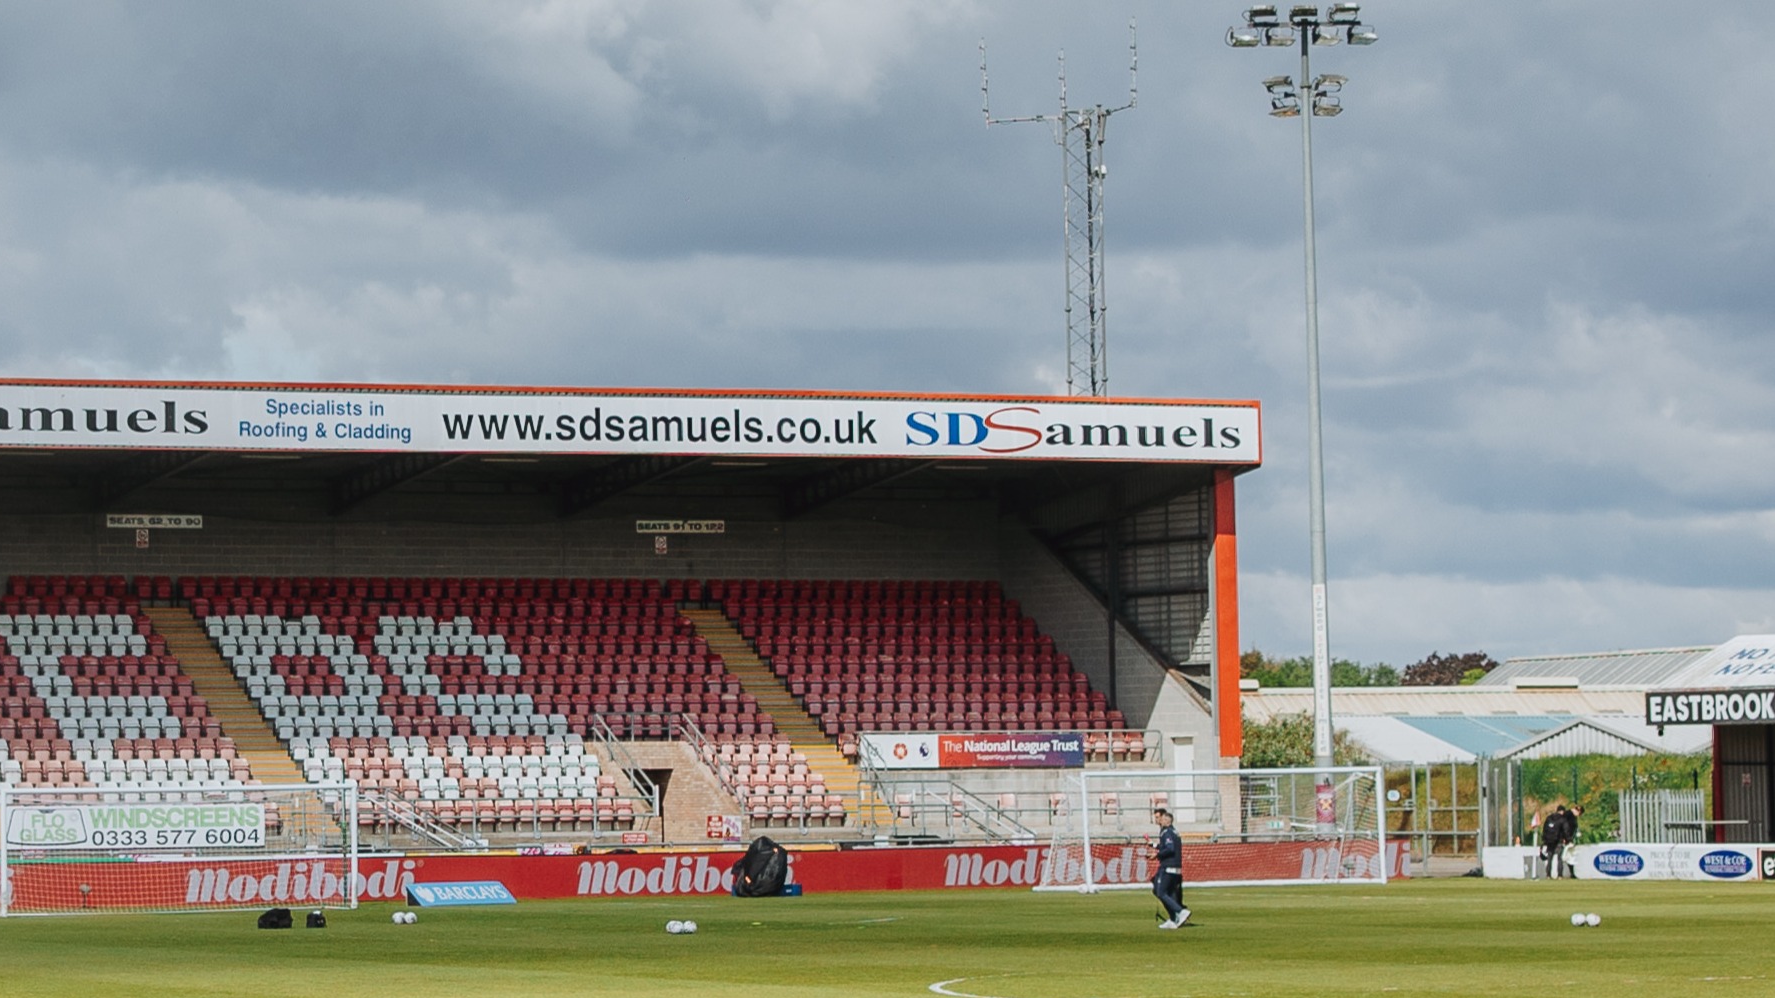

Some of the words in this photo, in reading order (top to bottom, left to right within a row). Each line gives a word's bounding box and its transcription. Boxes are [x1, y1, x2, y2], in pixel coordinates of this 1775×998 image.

[265, 398, 363, 418] Specialists
[369, 400, 385, 416] in
[239, 421, 308, 441] Roofing
[315, 423, 327, 438] &
[334, 422, 412, 443] Cladding
[442, 407, 877, 446] www.sdsamuels.co.uk
[109, 517, 145, 525] SEATS
[637, 522, 671, 530] SEATS
[1729, 648, 1769, 659] NO
[1714, 664, 1754, 675] NO
[942, 740, 963, 753] The
[964, 740, 1010, 754] National
[1011, 740, 1050, 755] League
[1050, 740, 1080, 752] Trust
[32, 814, 65, 829] FLO
[89, 805, 260, 829] WINDSCREENS
[20, 827, 78, 843] GLASS
[92, 829, 147, 847] 0333
[156, 829, 197, 845] 577
[205, 828, 260, 845] 6004
[944, 848, 1150, 886] Modibodi
[186, 860, 416, 902] Modibodi
[432, 885, 508, 900] BARCLAYS
